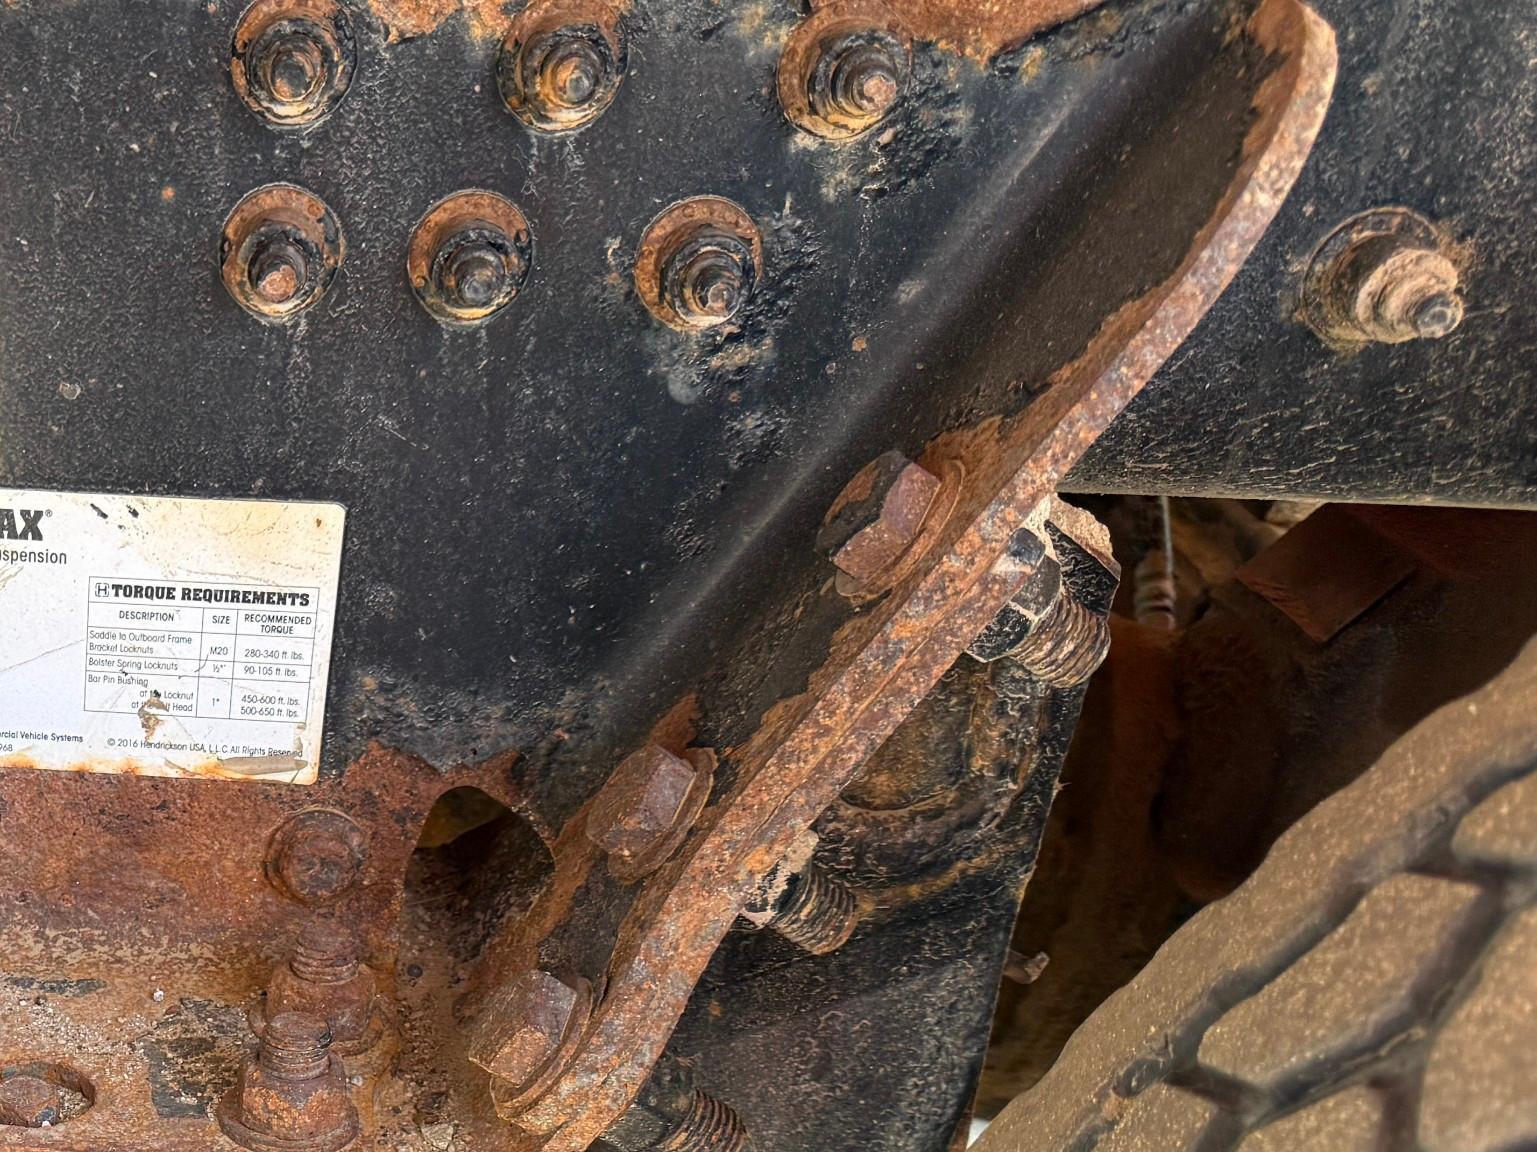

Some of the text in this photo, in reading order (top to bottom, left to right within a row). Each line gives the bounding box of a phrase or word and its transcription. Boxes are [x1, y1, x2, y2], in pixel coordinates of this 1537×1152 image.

[111, 584, 176, 600] TORQUE
[181, 587, 310, 606] REQUIREMENTS
[119, 610, 175, 621] DESCRIPTION
[212, 615, 231, 625] SIZE
[244, 613, 312, 625] RECOMMENDED
[260, 624, 294, 635] TORQUE
[89, 630, 192, 644] Saddle to Outboard Frame
[90, 642, 154, 654] Bracket Locknuts
[210, 646, 229, 656] M20
[244, 649, 280, 659] 280-340
[290, 651, 304, 660] lbs.
[88, 657, 178, 671] Bolster Spring Locknuts
[244, 665, 273, 676] 90-105
[284, 668, 298, 677] lbs.
[88, 674, 149, 688] Bar Pin Bushing
[139, 690, 148, 698] at
[164, 690, 194, 700] Locknut
[241, 695, 276, 705] 450-600
[286, 697, 301, 706] lbs.
[131, 700, 139, 709] at
[172, 702, 193, 712] Head
[240, 707, 275, 717] 500-650
[285, 709, 300, 718] lbs.
[20, 731, 49, 741] Vehicle
[51, 733, 84, 744] Systems
[117, 738, 139, 748] 2016
[140, 740, 188, 751] Hendrickson
[230, 745, 240, 754] All
[242, 746, 266, 757] Rights
[267, 747, 303, 758] Reserved
